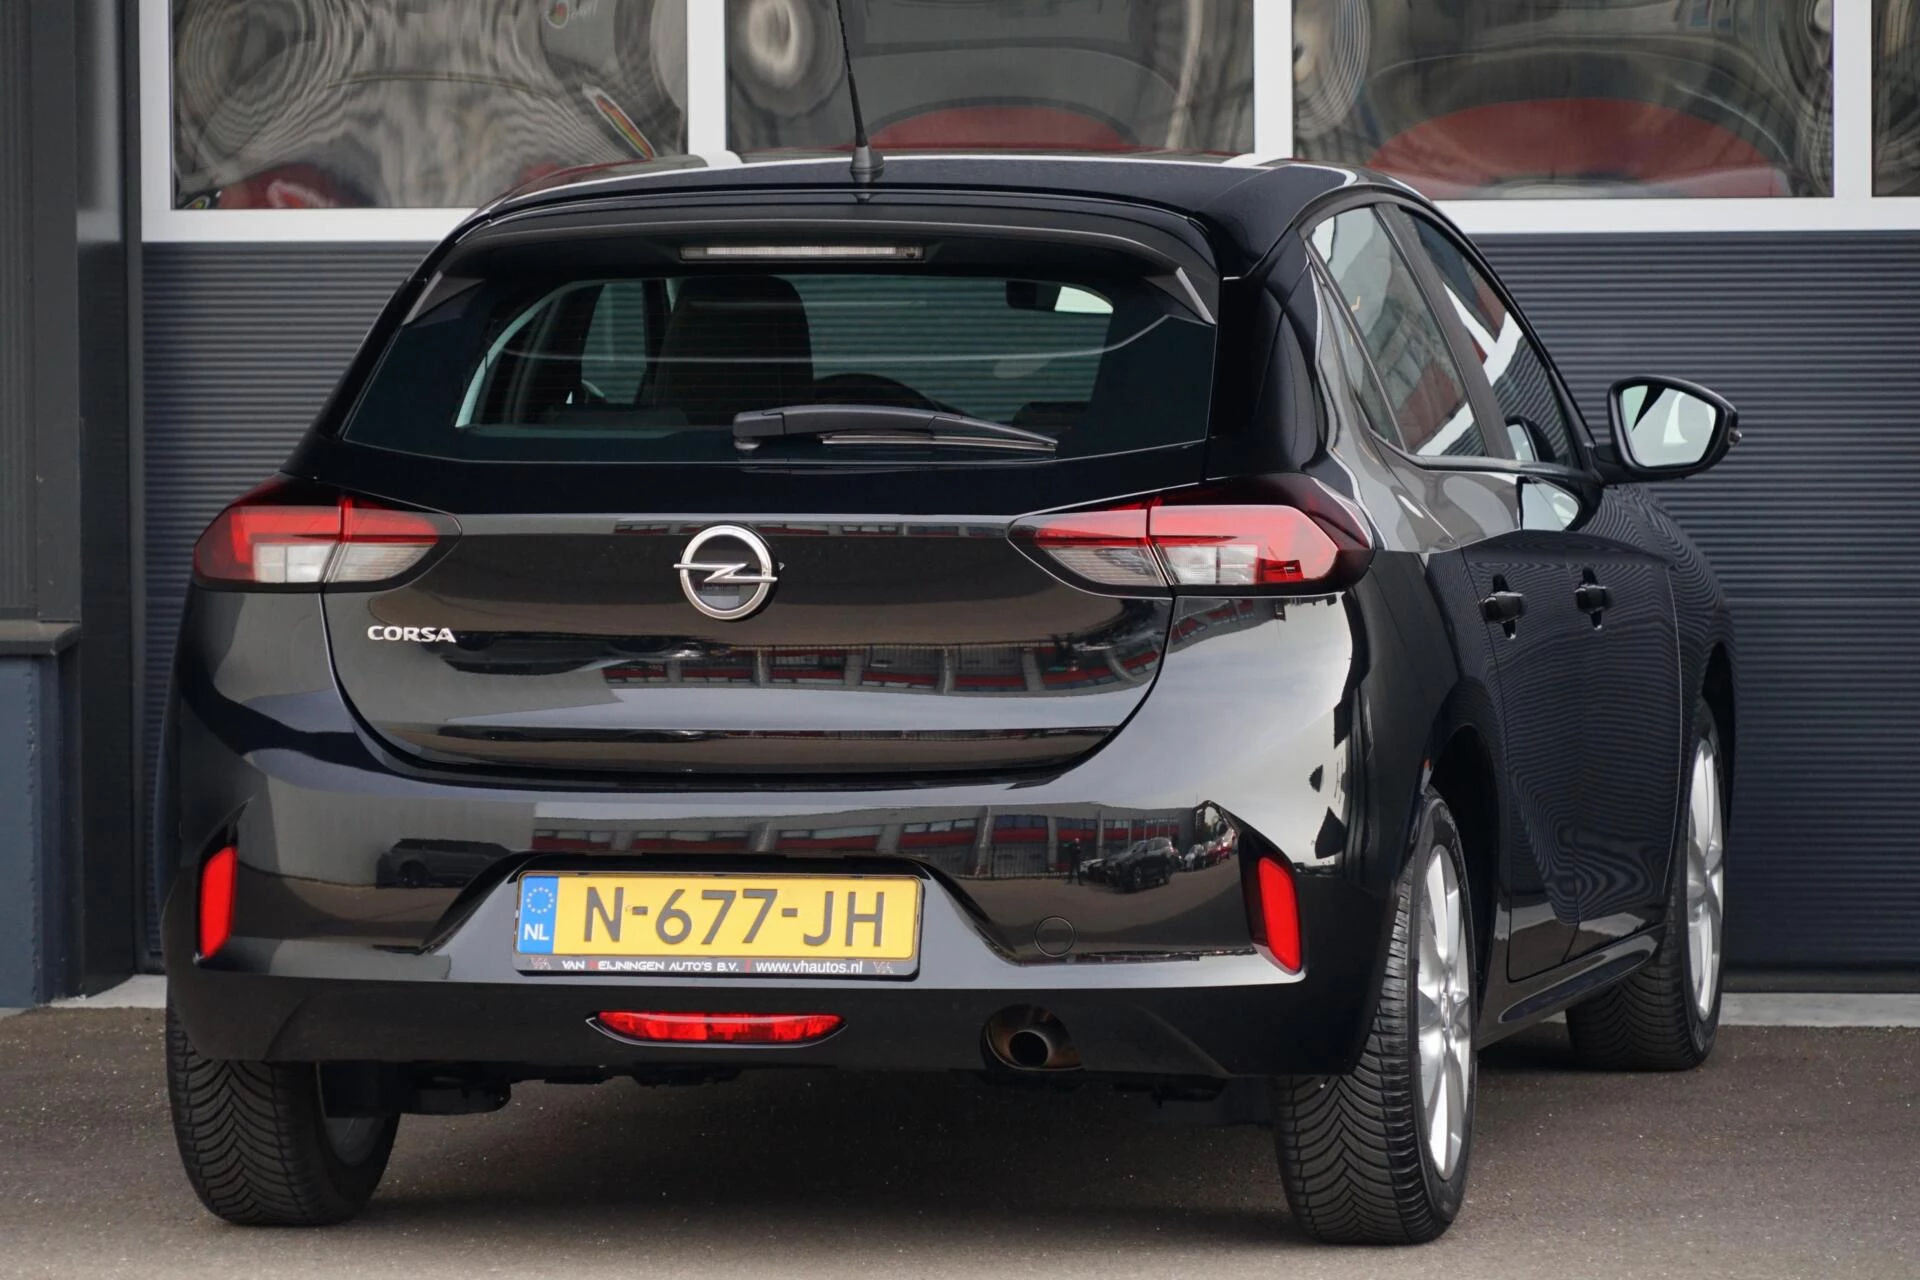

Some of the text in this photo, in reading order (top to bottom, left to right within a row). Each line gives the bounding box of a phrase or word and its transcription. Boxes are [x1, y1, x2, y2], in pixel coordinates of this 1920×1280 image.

[367, 625, 456, 643] CORSA
[583, 886, 885, 948] N-677-JH
[524, 923, 550, 941] NL
[562, 960, 585, 970] VAN
[668, 961, 712, 971] AUTO'S
[717, 962, 739, 971] B.V.
[756, 961, 863, 974] www.vhautos.nl
